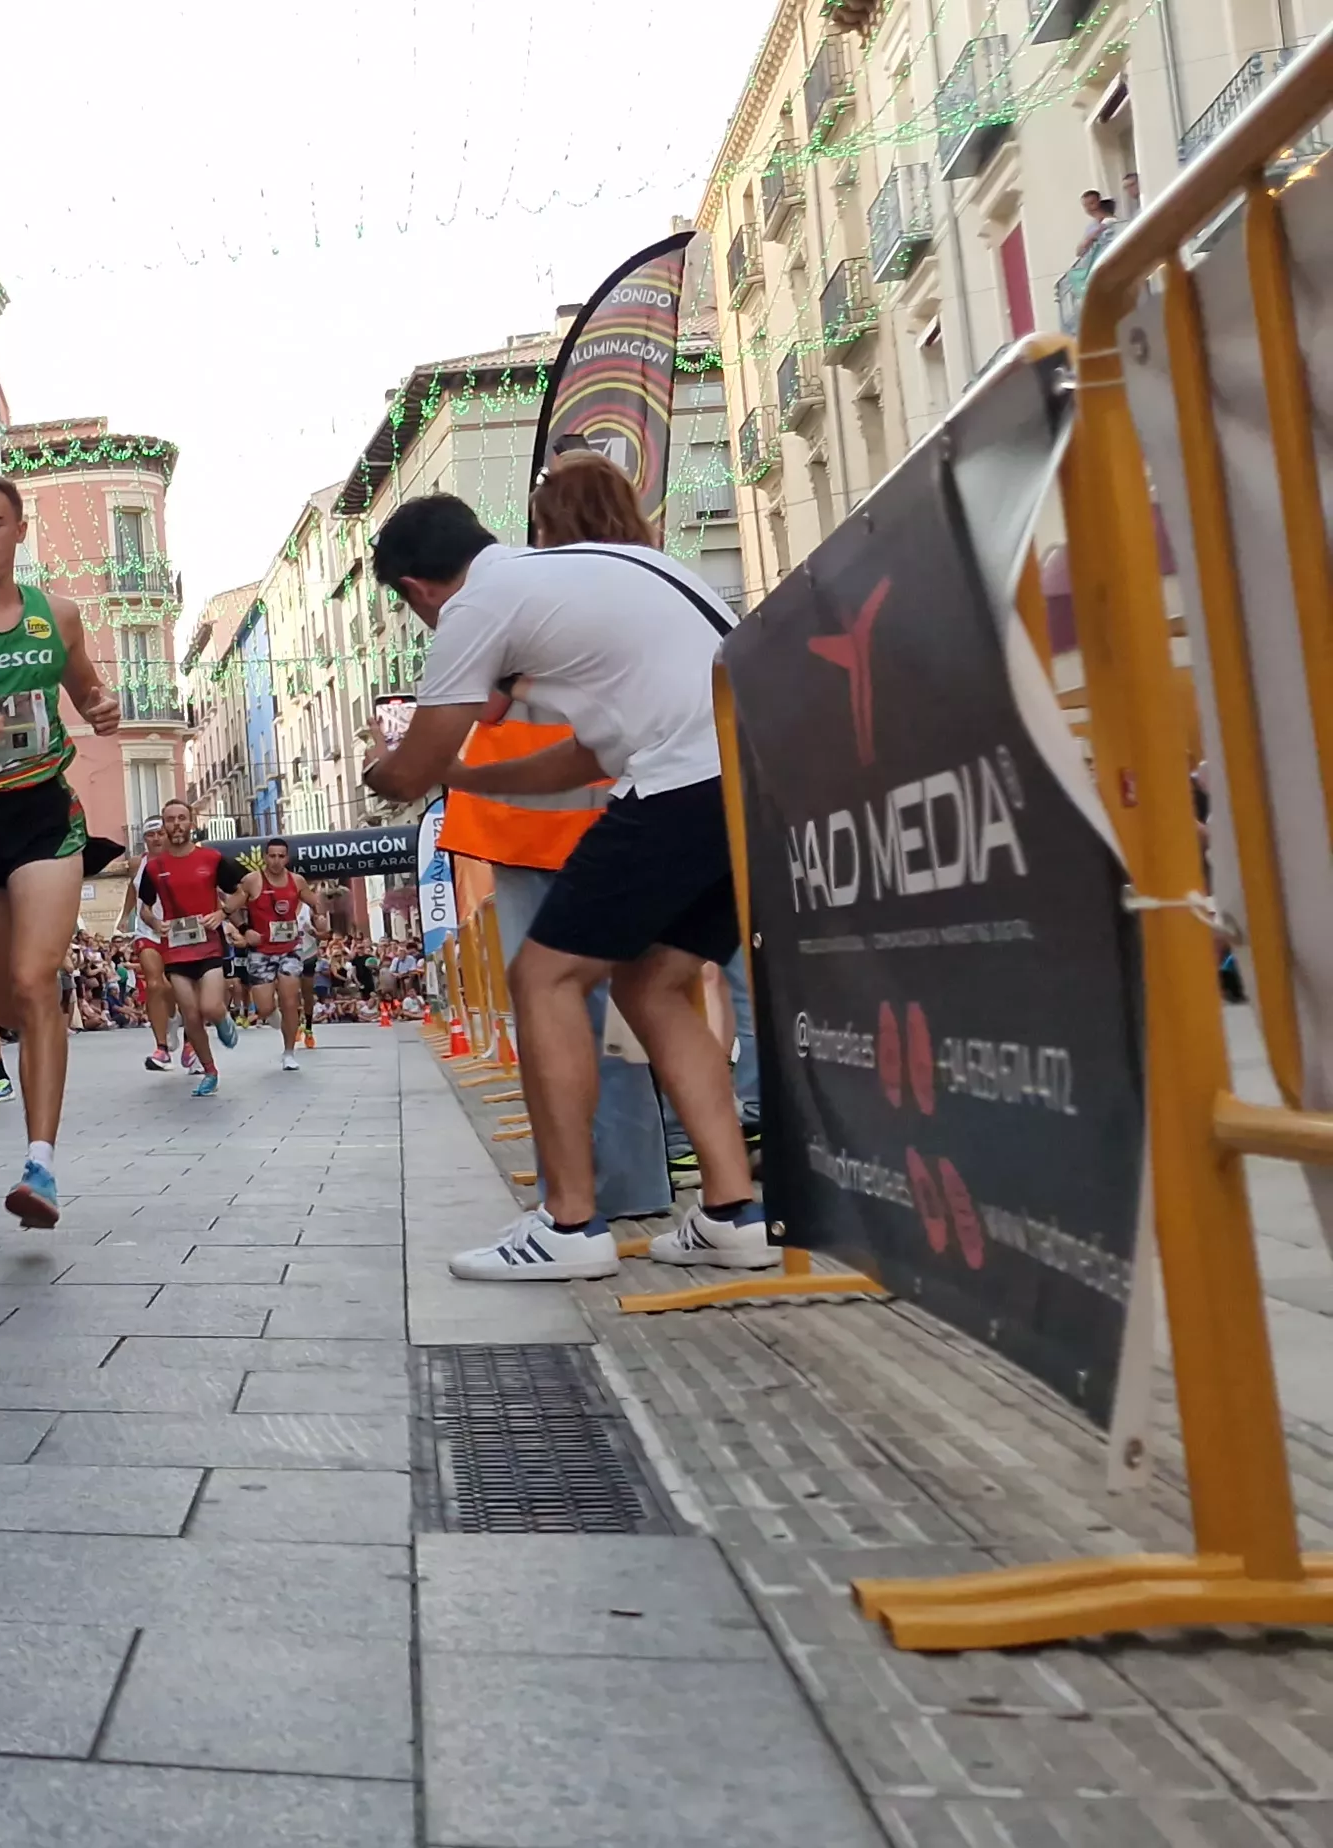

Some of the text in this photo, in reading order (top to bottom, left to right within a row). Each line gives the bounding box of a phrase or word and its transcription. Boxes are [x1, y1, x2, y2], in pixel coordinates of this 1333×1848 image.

[611, 287, 672, 308] SONIDO
[570, 338, 669, 366] ILUMINACIÓN
[786, 809, 860, 913] HAD
[865, 755, 1029, 901] MEDIA
[297, 835, 408, 861] FUNDACIÓN
[310, 862, 354, 873] RURAL
[358, 859, 375, 869] DE
[380, 855, 417, 867] ARAG
